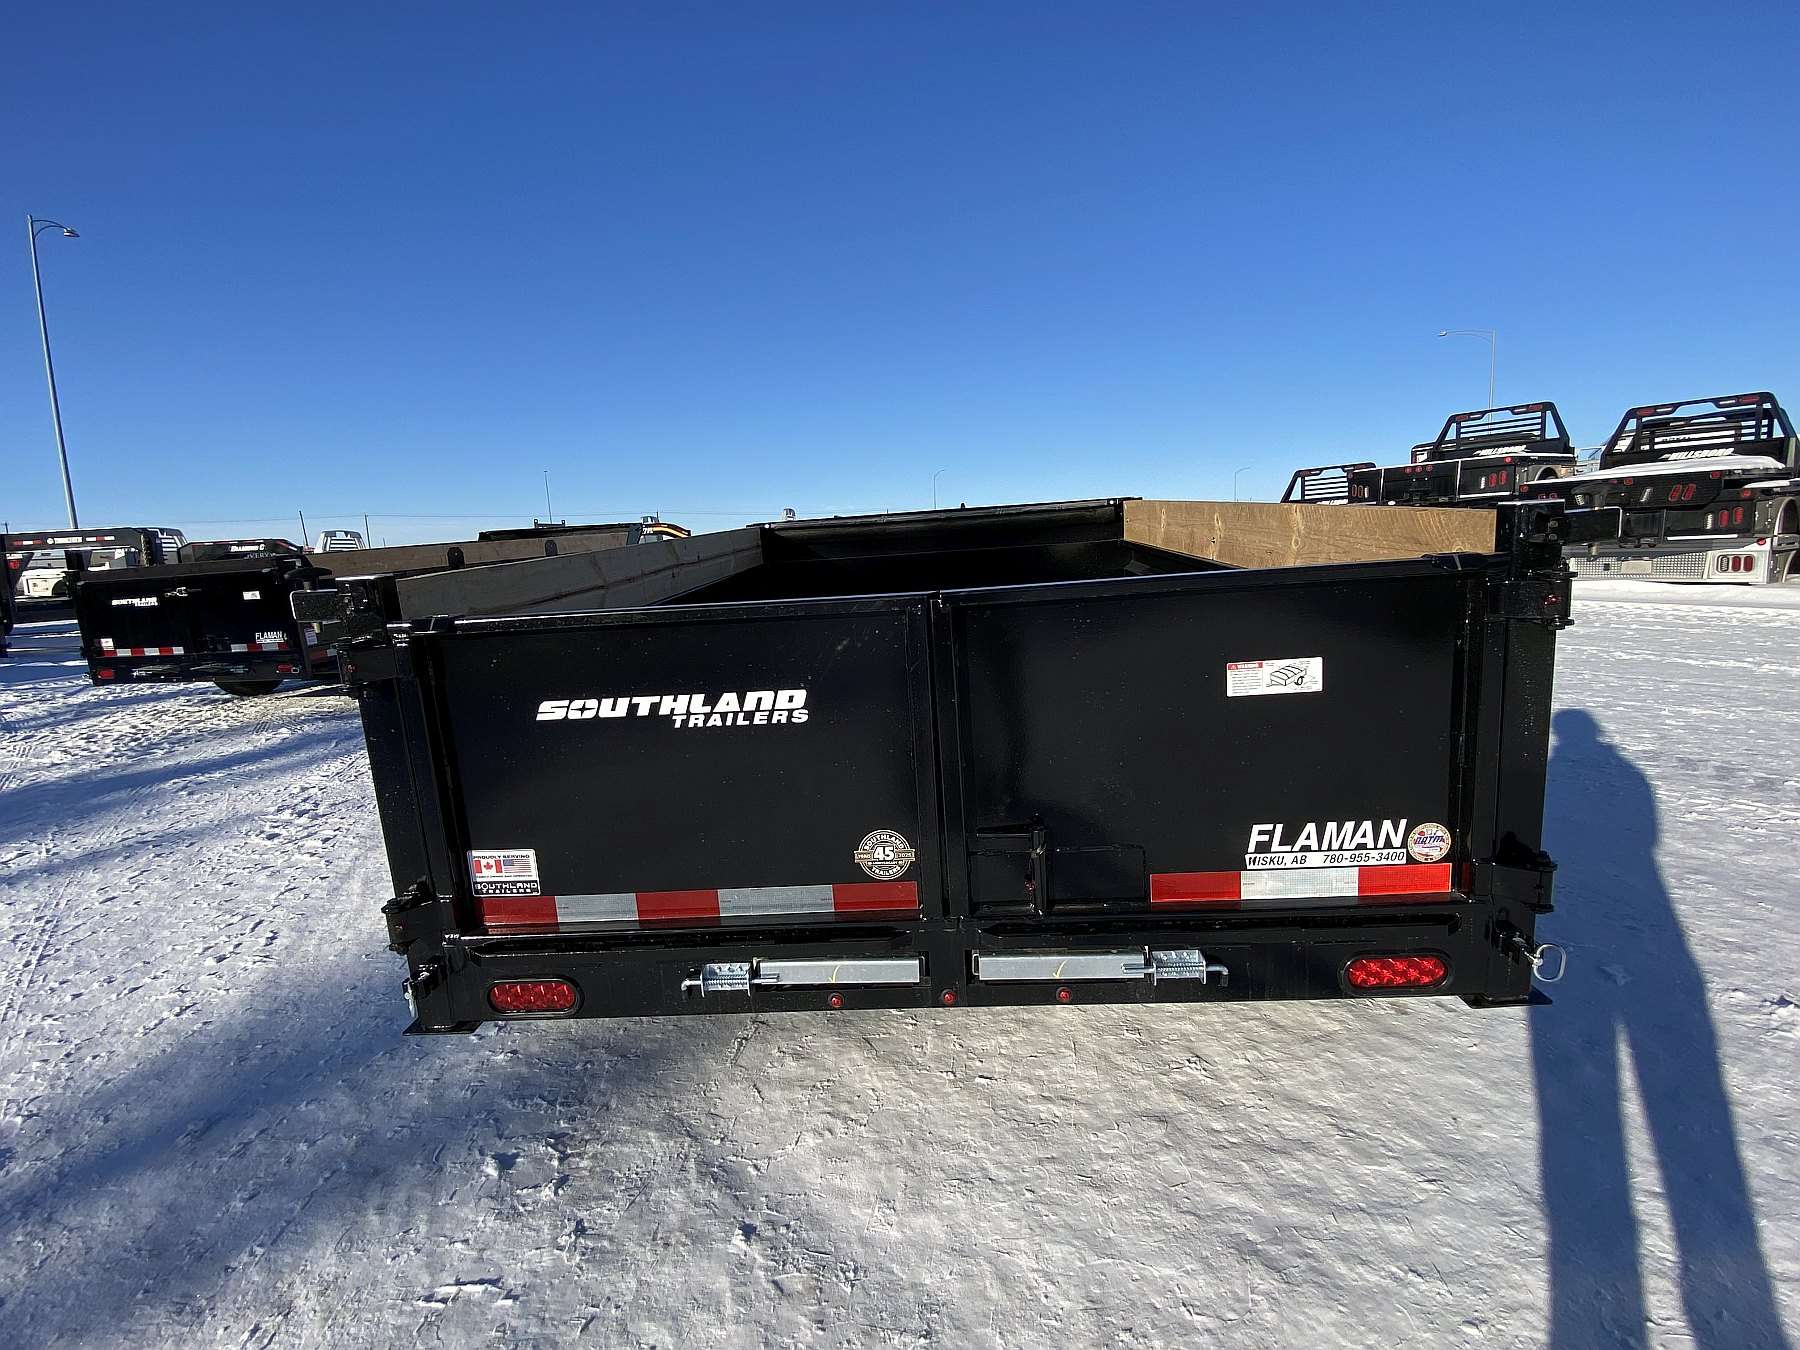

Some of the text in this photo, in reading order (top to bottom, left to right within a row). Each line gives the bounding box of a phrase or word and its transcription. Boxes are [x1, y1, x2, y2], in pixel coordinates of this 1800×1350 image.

[256, 631, 283, 640] FLAMAN
[536, 689, 808, 721] SOUTHLAND
[672, 709, 809, 729] TRAILERS
[864, 834, 904, 850] SOUTHLAND
[1247, 818, 1408, 853] FLAMAN
[873, 846, 896, 861] 45
[1248, 851, 1405, 867] NISKU, AB 780-955-3400
[475, 882, 538, 890] SOUTHLAND
